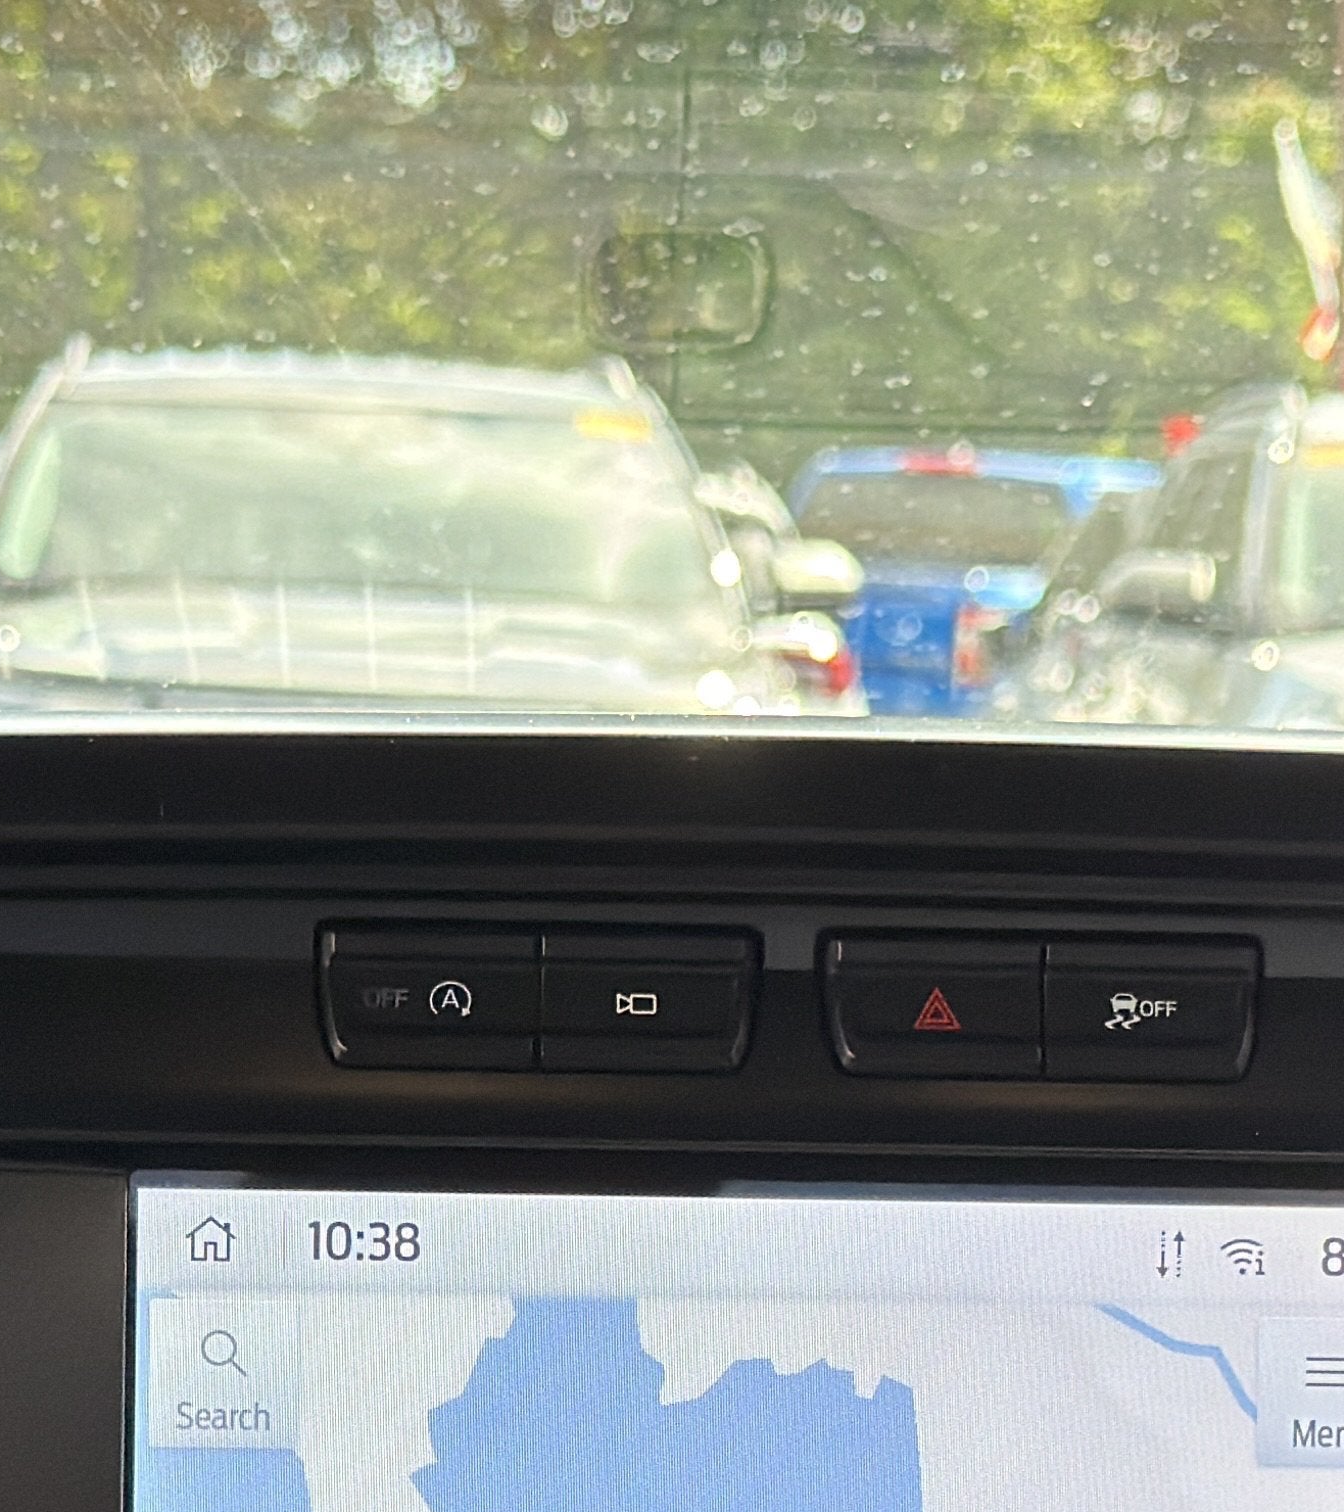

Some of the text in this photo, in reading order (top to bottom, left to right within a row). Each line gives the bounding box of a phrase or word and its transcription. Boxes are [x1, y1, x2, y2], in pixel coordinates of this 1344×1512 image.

[1139, 1000, 1178, 1018] OFF
[307, 1220, 421, 1262] 10:38
[175, 1401, 270, 1431] Search
